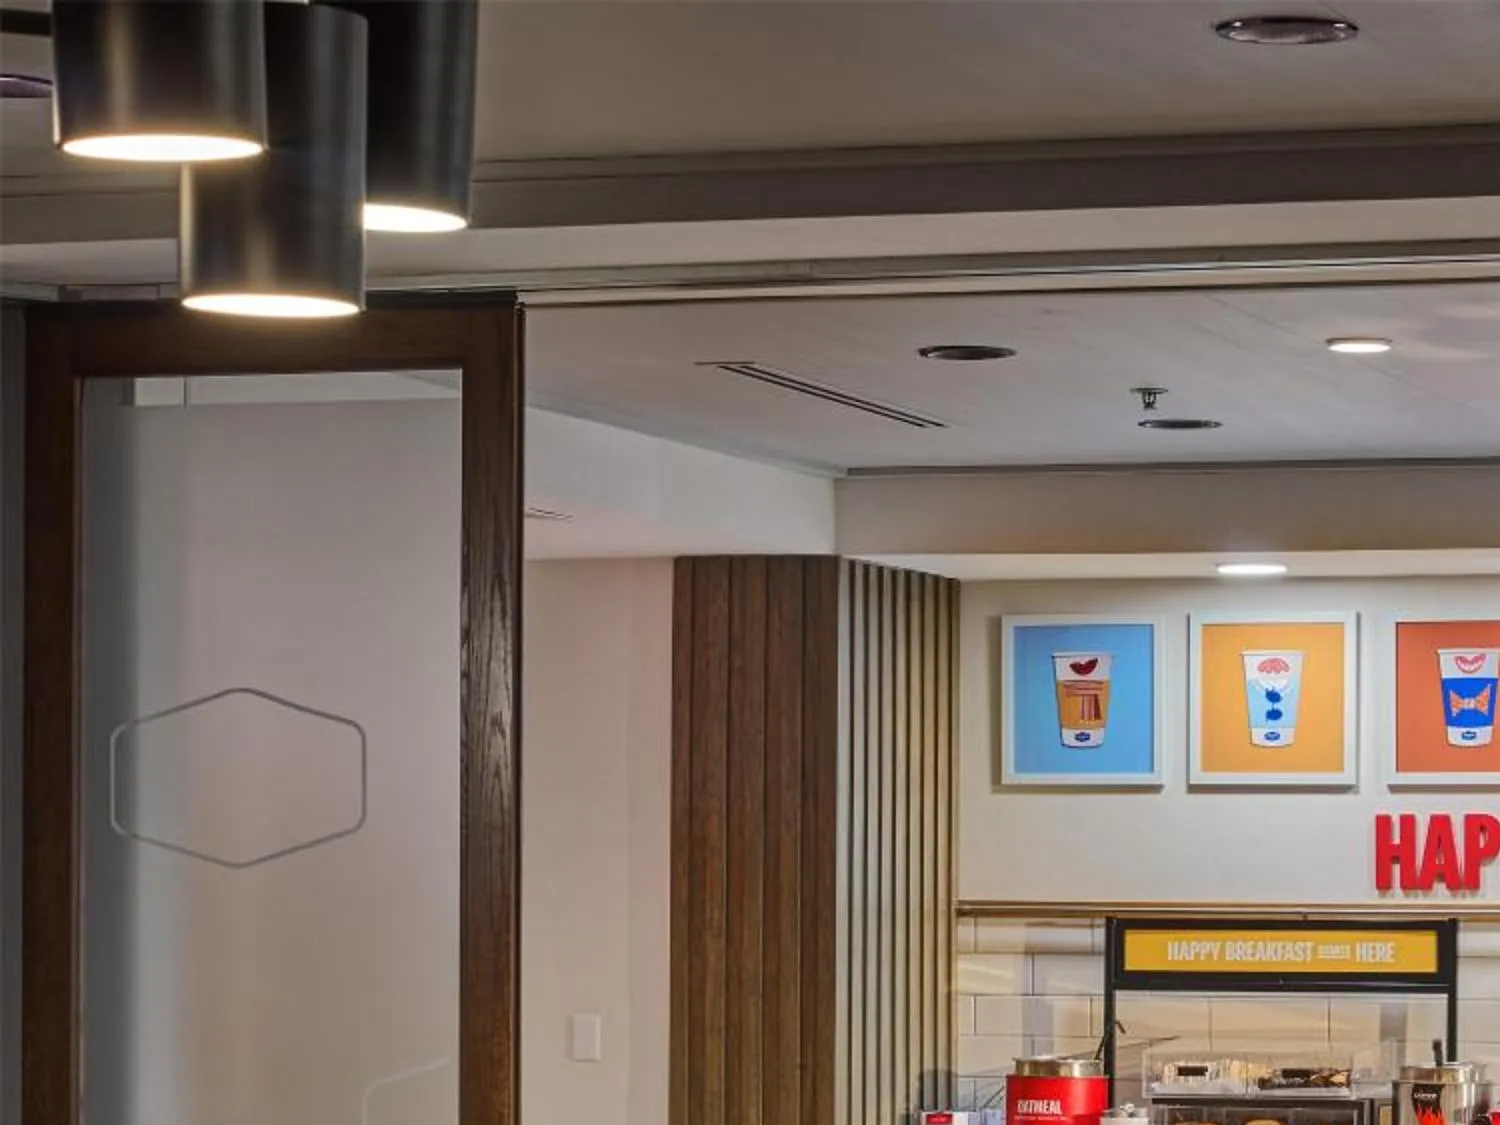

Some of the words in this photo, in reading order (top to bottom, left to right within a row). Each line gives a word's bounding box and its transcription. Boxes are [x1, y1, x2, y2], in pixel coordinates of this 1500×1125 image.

[1167, 940, 1221, 961] HAPPY
[1225, 940, 1314, 961] BREAKFAST
[1355, 942, 1396, 962] HERE
[1017, 1099, 1062, 1114] OATMEAL
